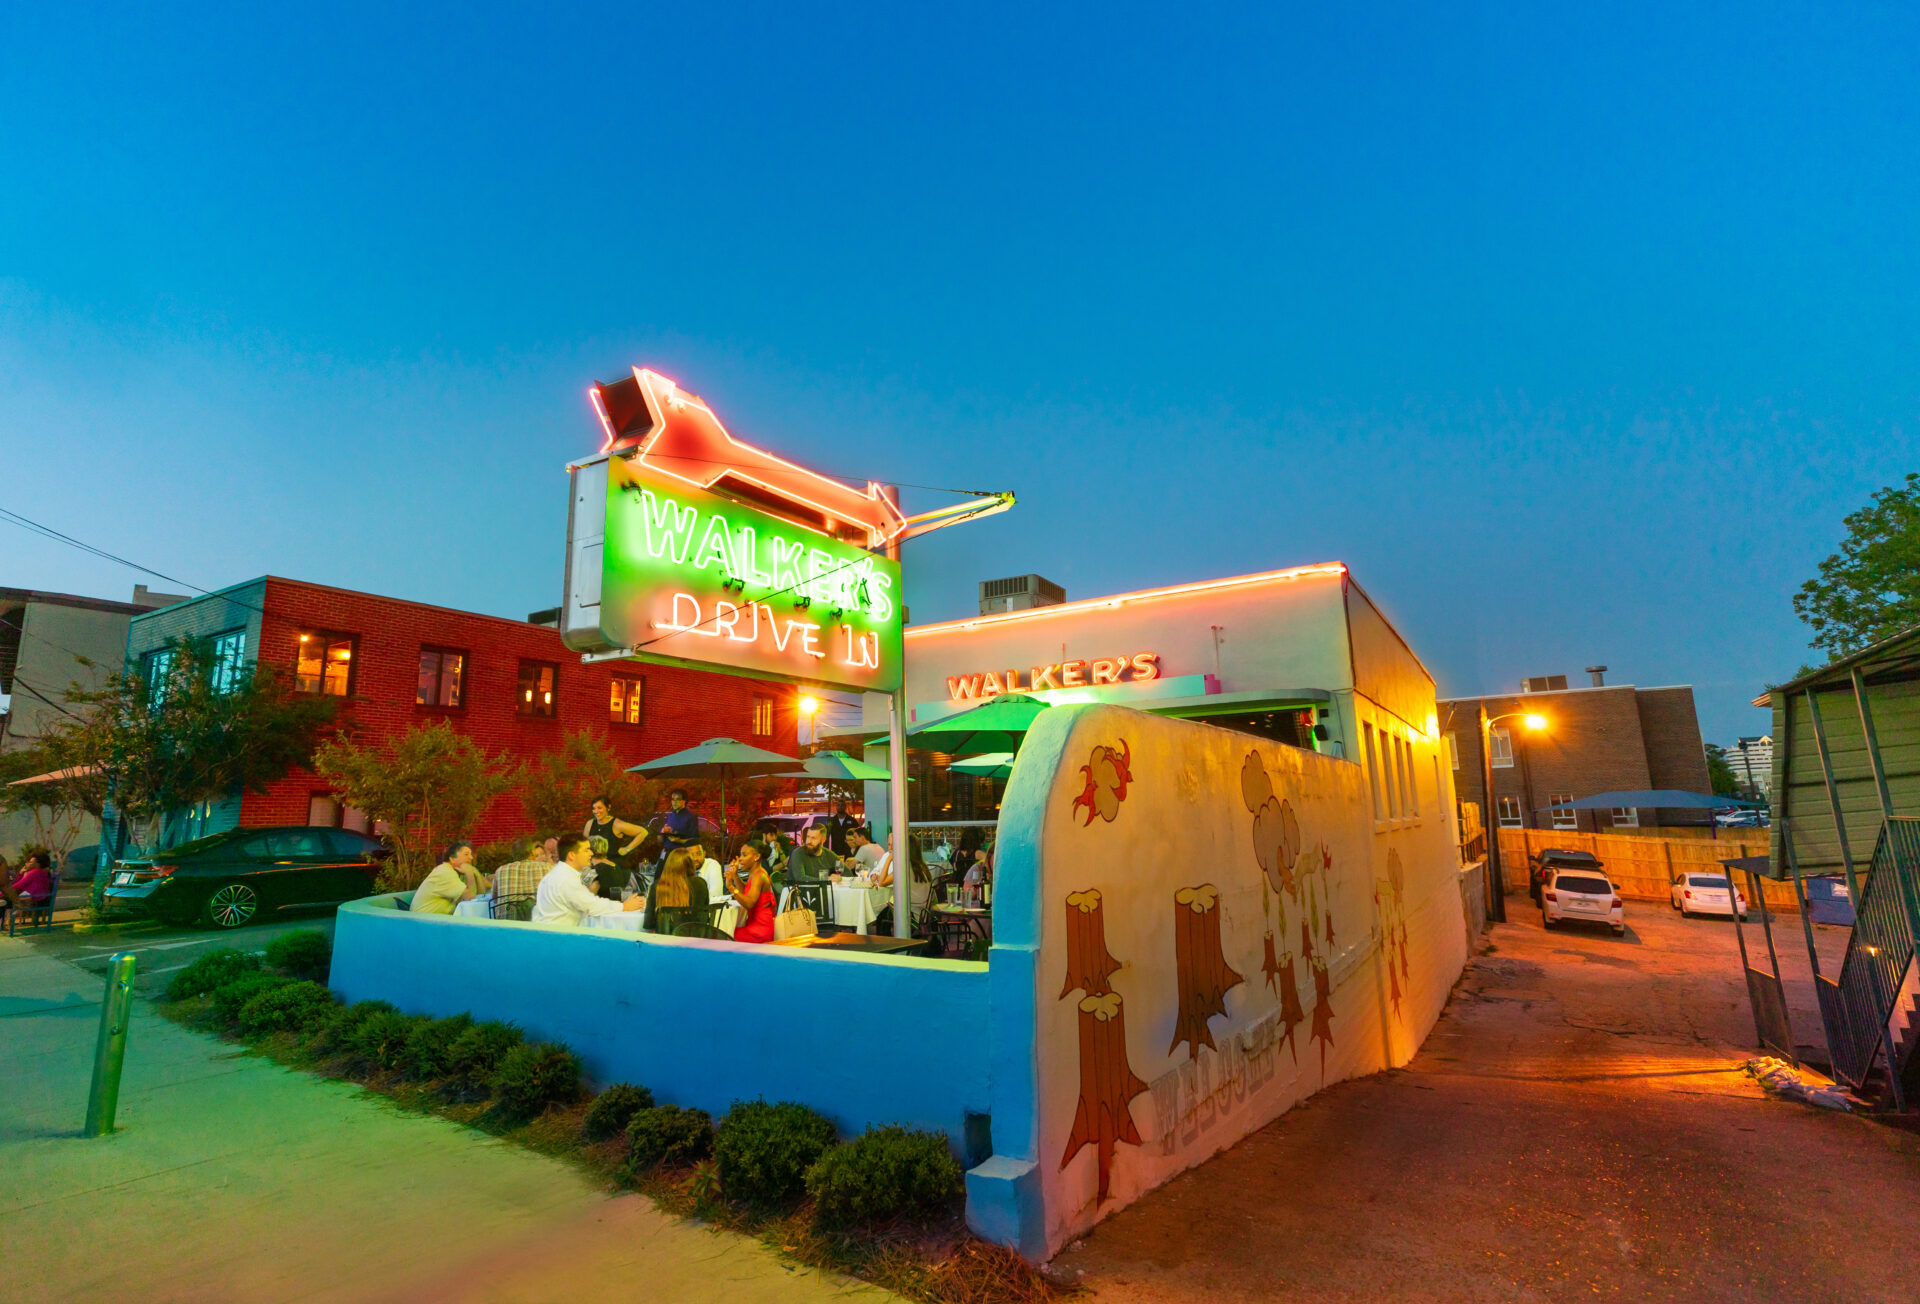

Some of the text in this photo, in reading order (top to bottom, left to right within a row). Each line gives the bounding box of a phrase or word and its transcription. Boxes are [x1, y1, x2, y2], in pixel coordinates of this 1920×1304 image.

[641, 489, 892, 622] WALKER'S
[653, 592, 879, 669] DRIVE IN
[946, 651, 1161, 700] WALKER'S
